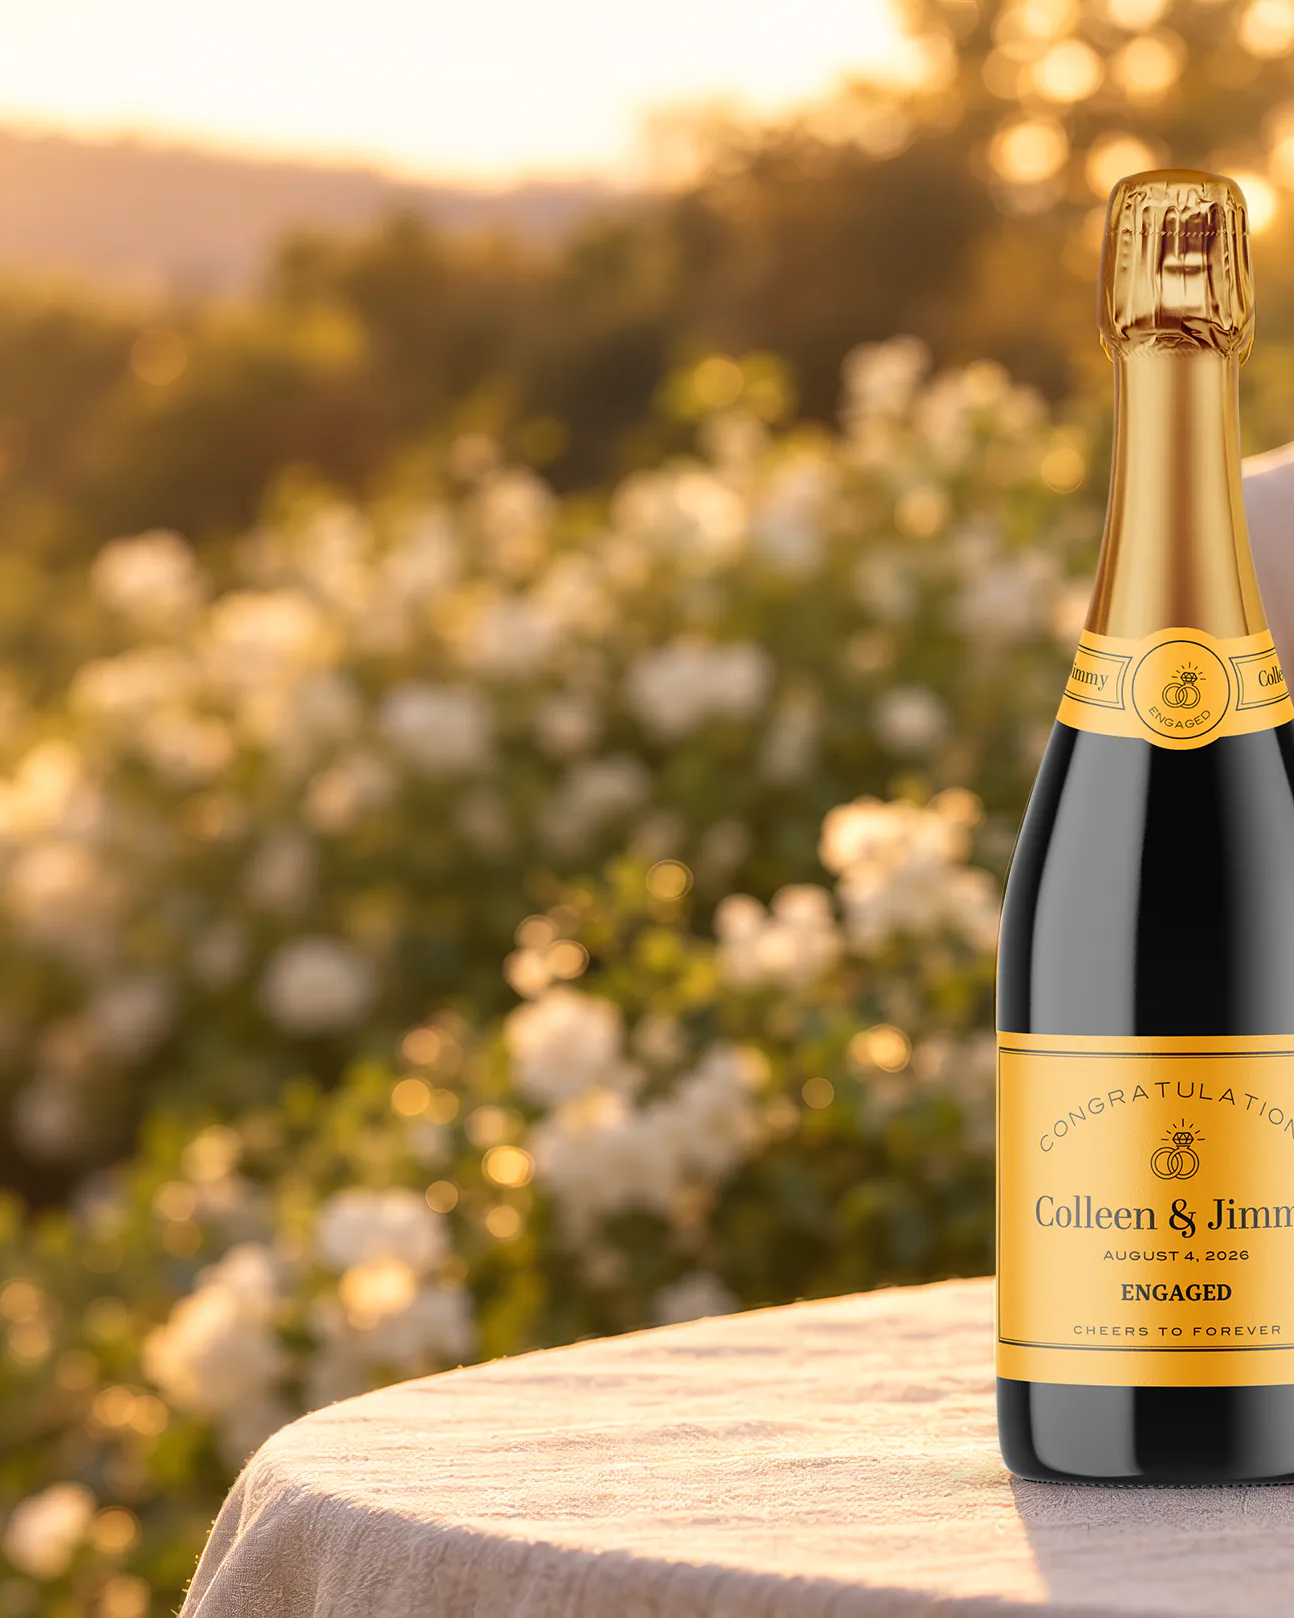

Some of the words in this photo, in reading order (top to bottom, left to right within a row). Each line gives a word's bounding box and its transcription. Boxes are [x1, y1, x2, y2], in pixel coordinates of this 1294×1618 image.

[1070, 662, 1109, 691] immy
[1149, 706, 1211, 729] ENGAGED
[1036, 1195, 1157, 1230] Colleen
[1169, 1198, 1196, 1238] &
[1103, 1250, 1179, 1261] AUGUST
[1184, 1251, 1200, 1262] 4,
[1205, 1250, 1249, 1261] 2026
[1121, 1284, 1232, 1301] ENGAGED
[1073, 1325, 1149, 1336] CHEERS
[1158, 1326, 1182, 1337] TO
[1193, 1325, 1282, 1336] FOREVER
